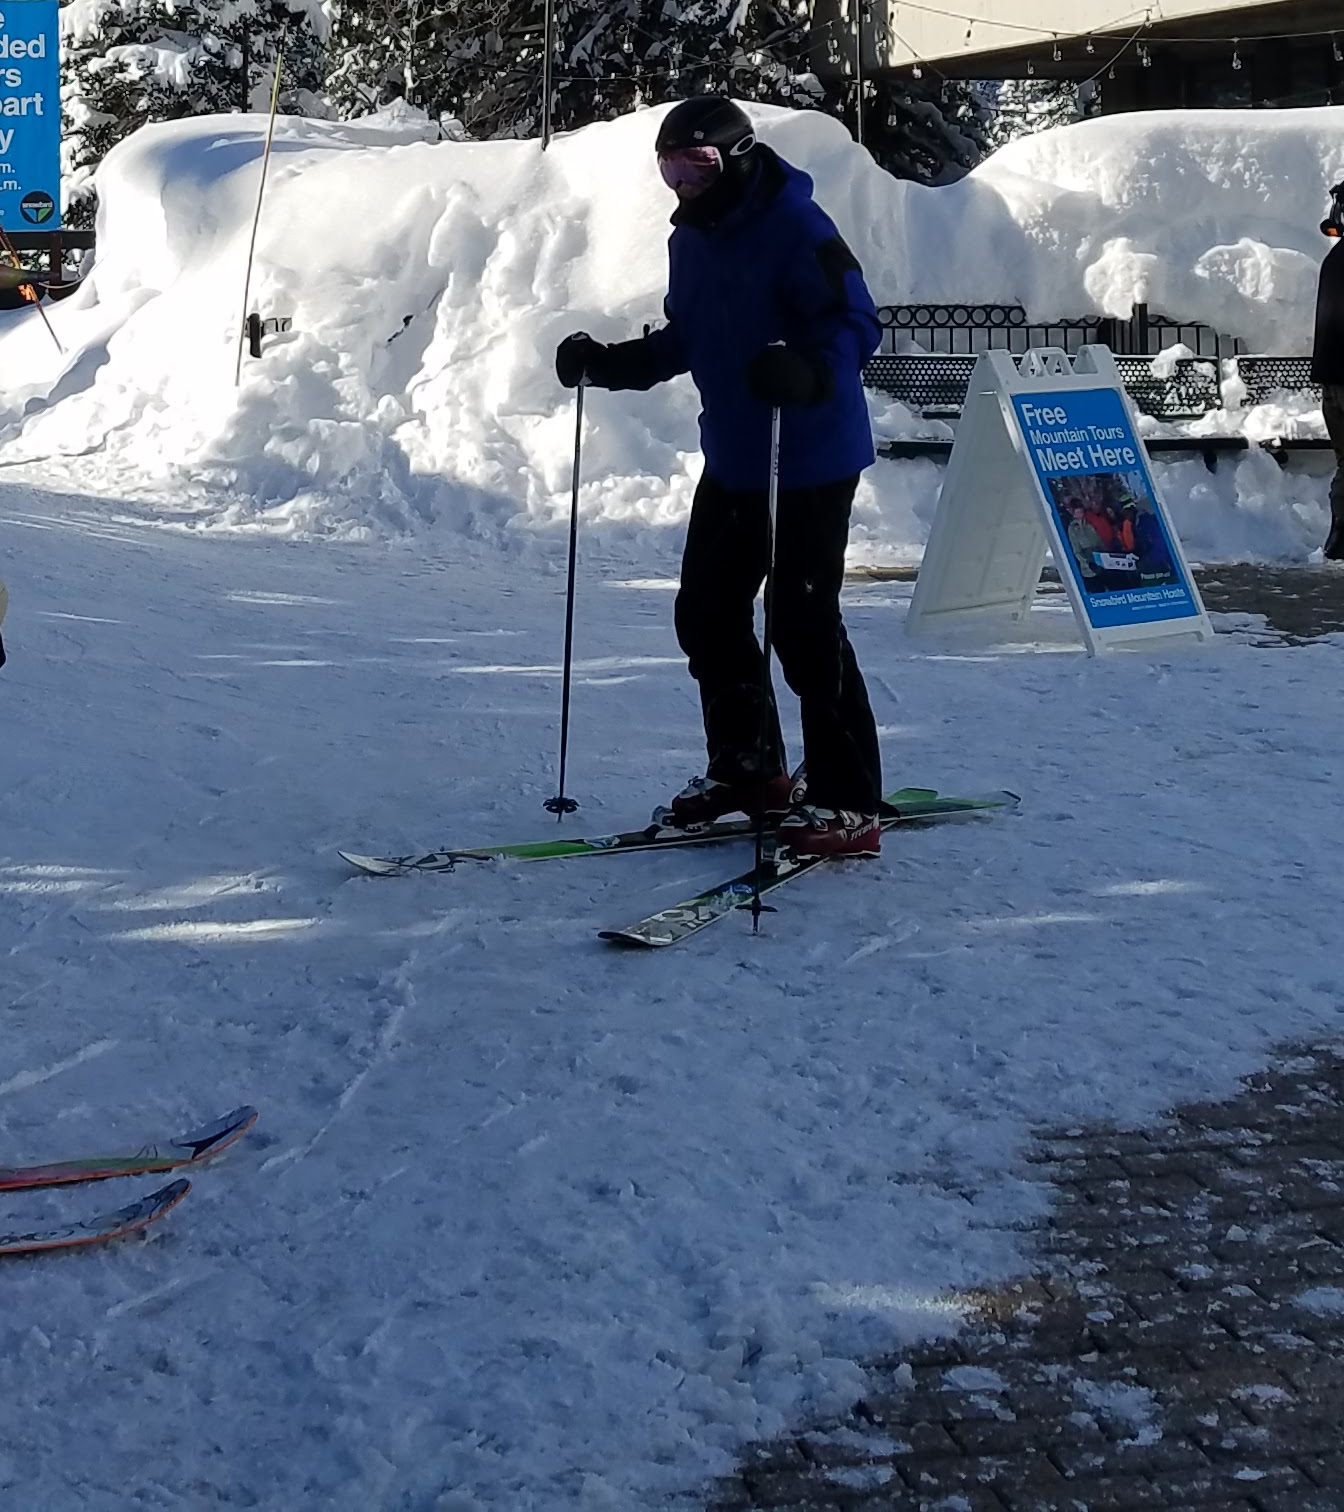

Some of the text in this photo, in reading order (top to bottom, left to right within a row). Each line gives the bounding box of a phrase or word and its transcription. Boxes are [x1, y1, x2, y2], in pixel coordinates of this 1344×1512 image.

[1020, 403, 1068, 426] Free
[1029, 425, 1125, 445] Mountain Tours
[1036, 444, 1136, 472] Meet Here
[1090, 593, 1127, 608] Snowbird
[1127, 590, 1163, 604] Mountain
[1162, 588, 1186, 600] Hosts
